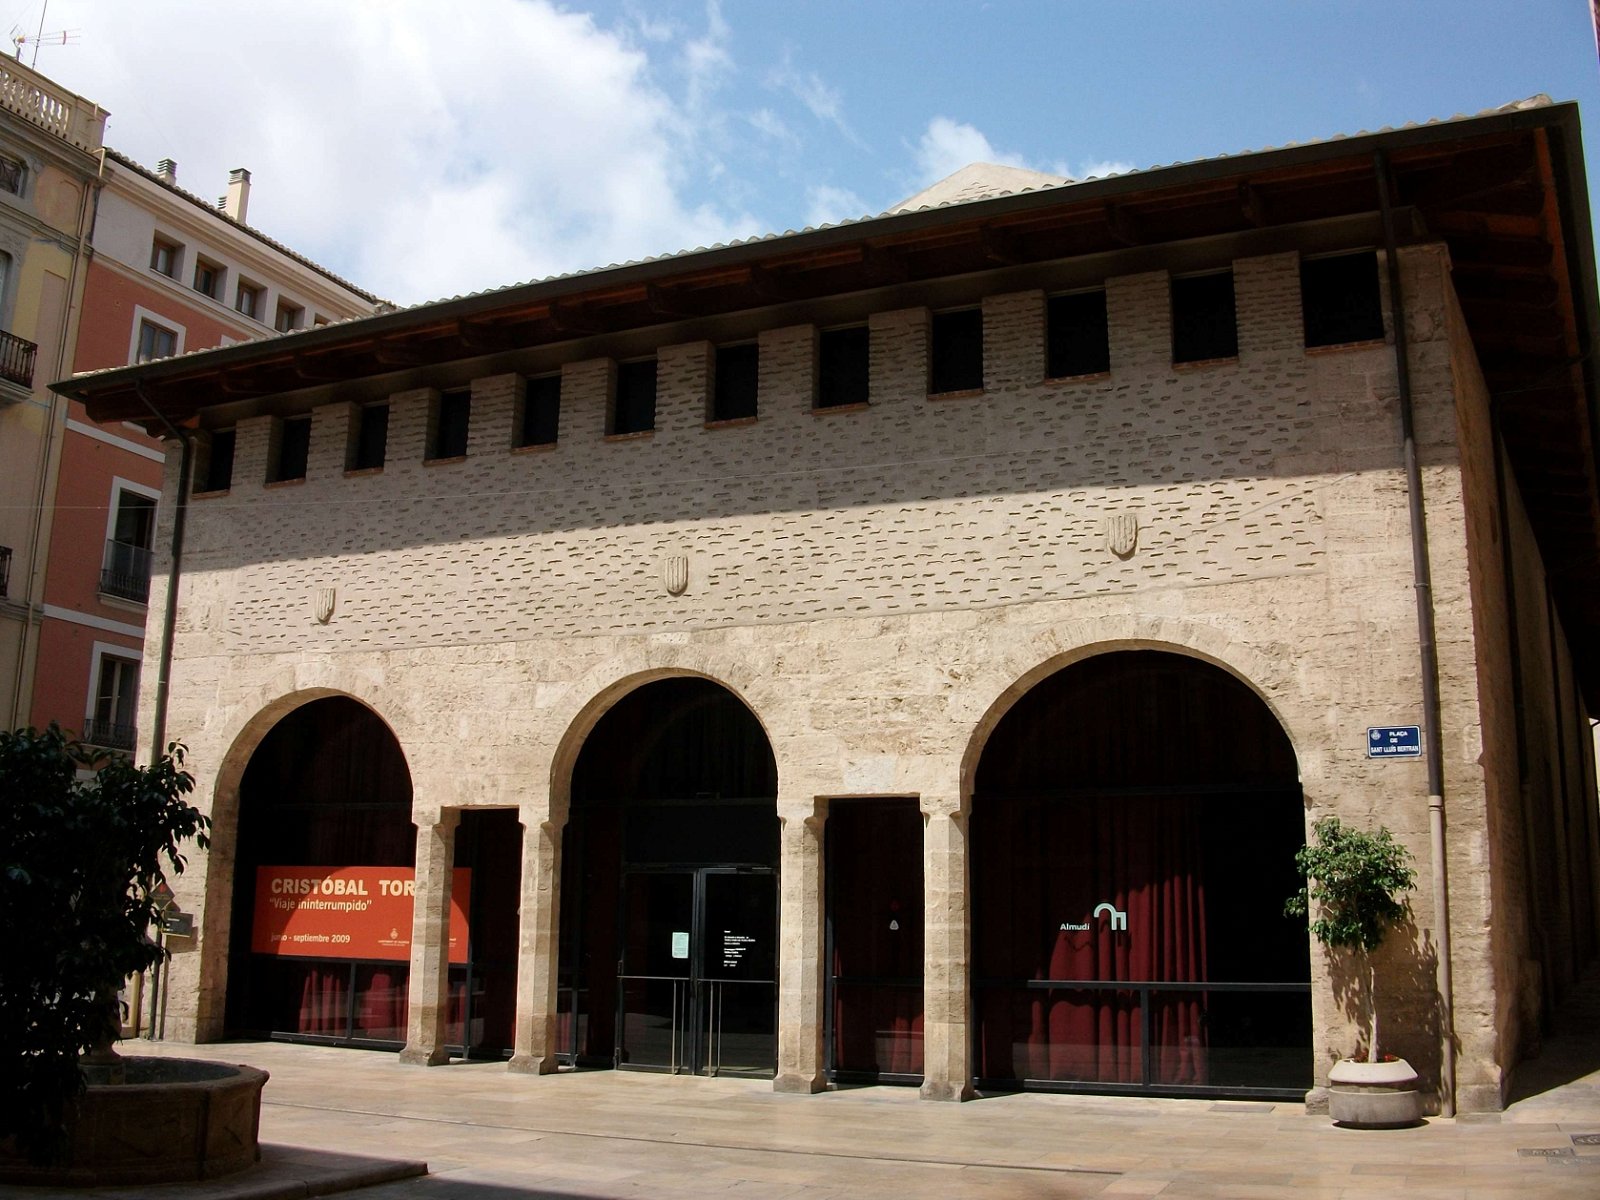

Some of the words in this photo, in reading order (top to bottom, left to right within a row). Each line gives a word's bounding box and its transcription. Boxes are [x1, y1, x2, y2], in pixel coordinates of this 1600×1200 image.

[271, 876, 368, 895] CRISTÓBAL
[293, 934, 330, 944] septiembre
[331, 935, 351, 944] 2009
